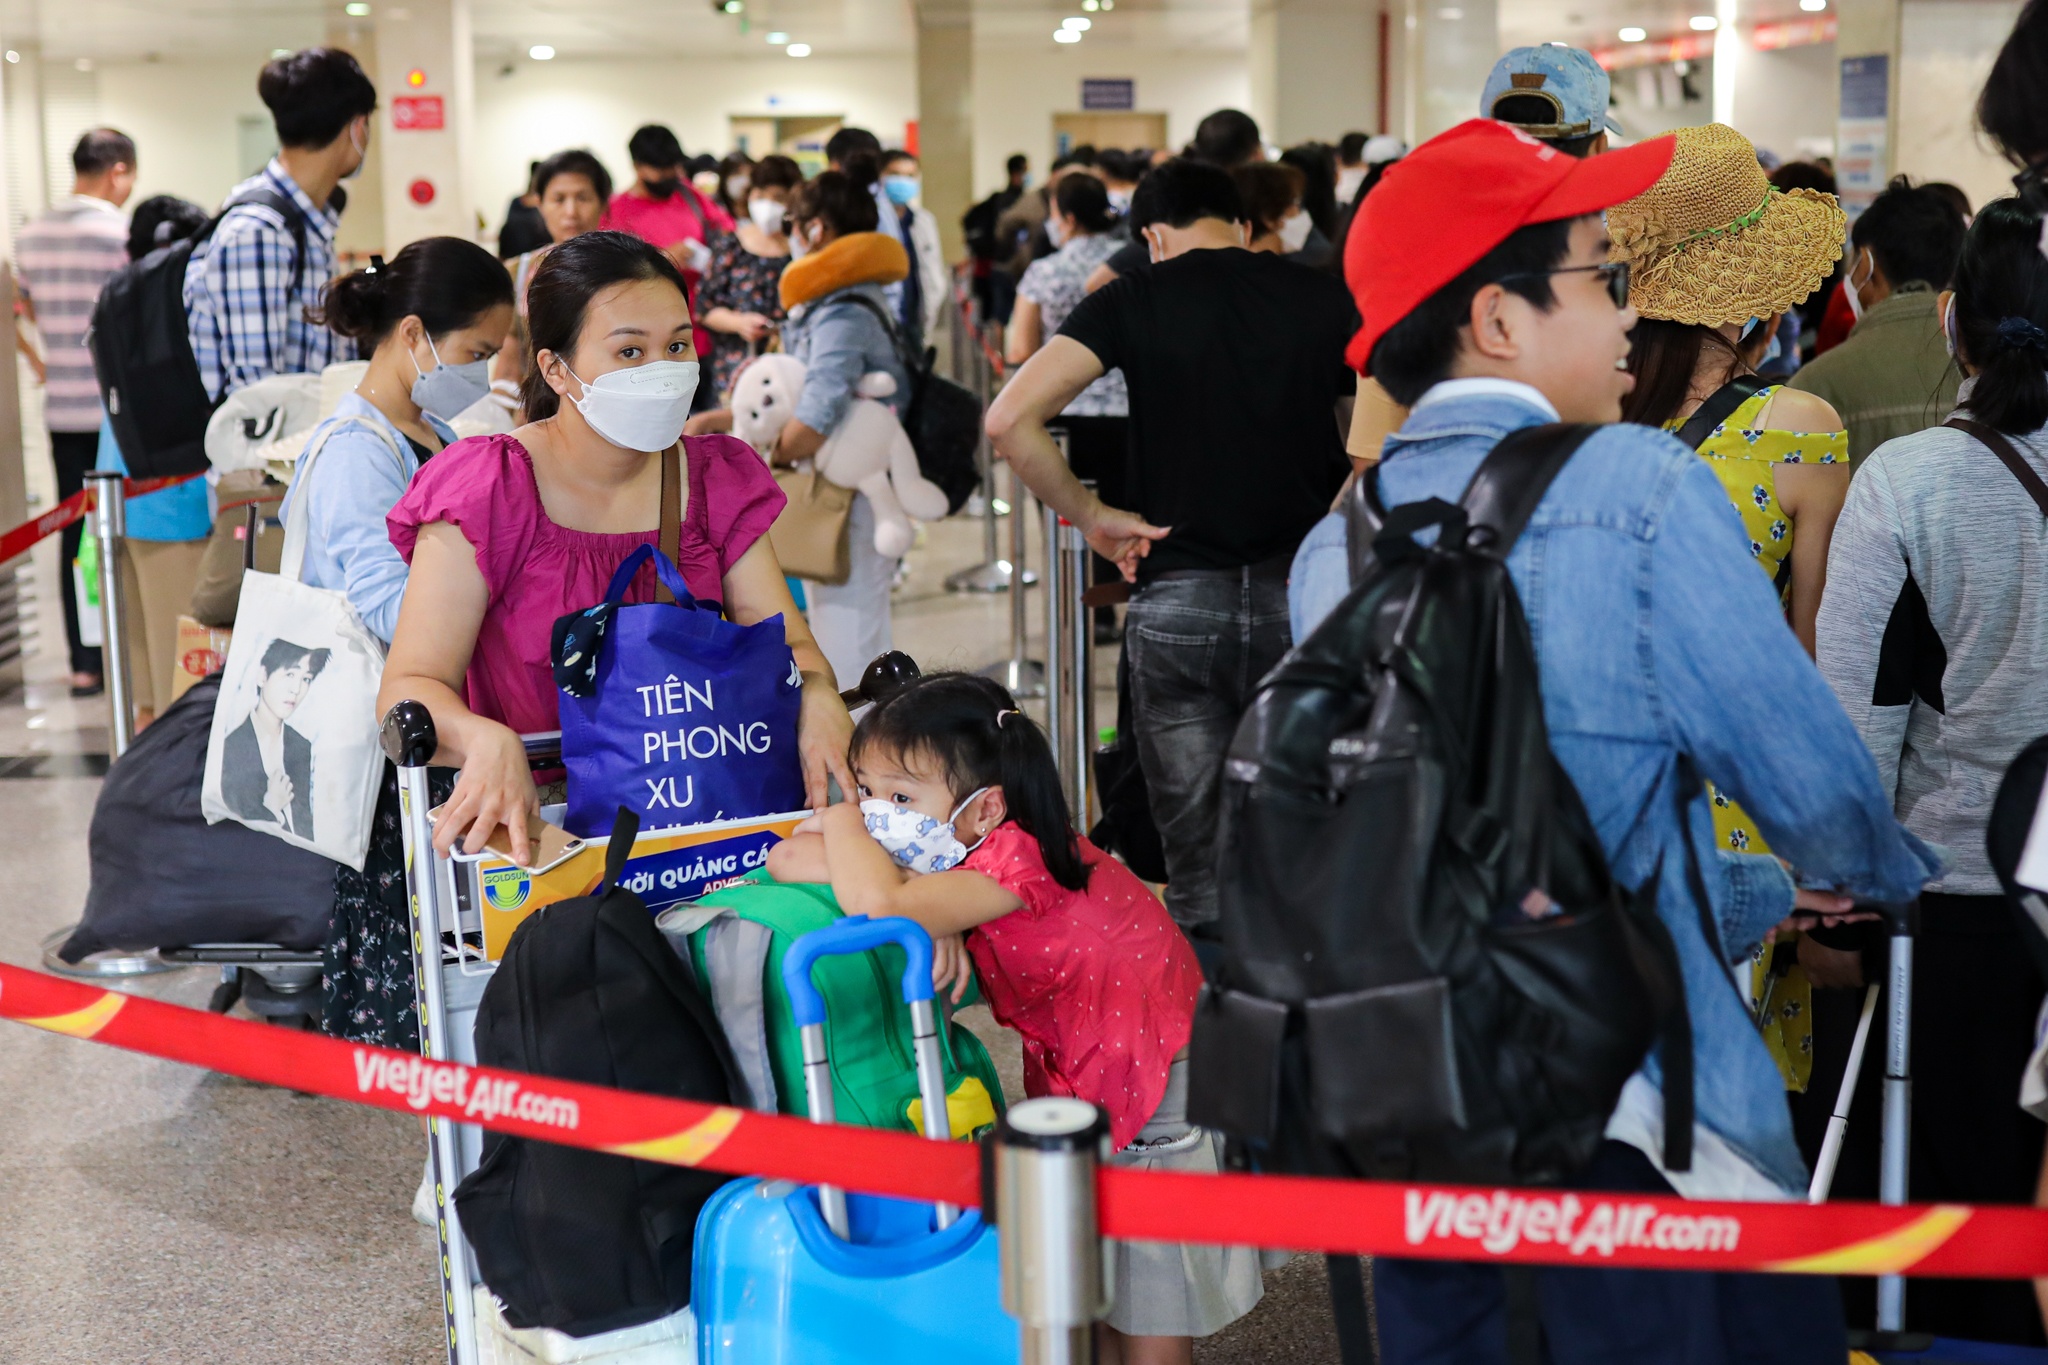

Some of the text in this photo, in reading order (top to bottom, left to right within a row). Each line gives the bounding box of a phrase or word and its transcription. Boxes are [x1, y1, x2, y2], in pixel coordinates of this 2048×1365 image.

[636, 673, 714, 717] TIÊN
[643, 721, 771, 764] PHONG
[645, 775, 694, 810] XU
[484, 871, 530, 884] GOLDSUN
[659, 856, 738, 889] QUẢNG
[436, 1182, 457, 1349] GROUP
